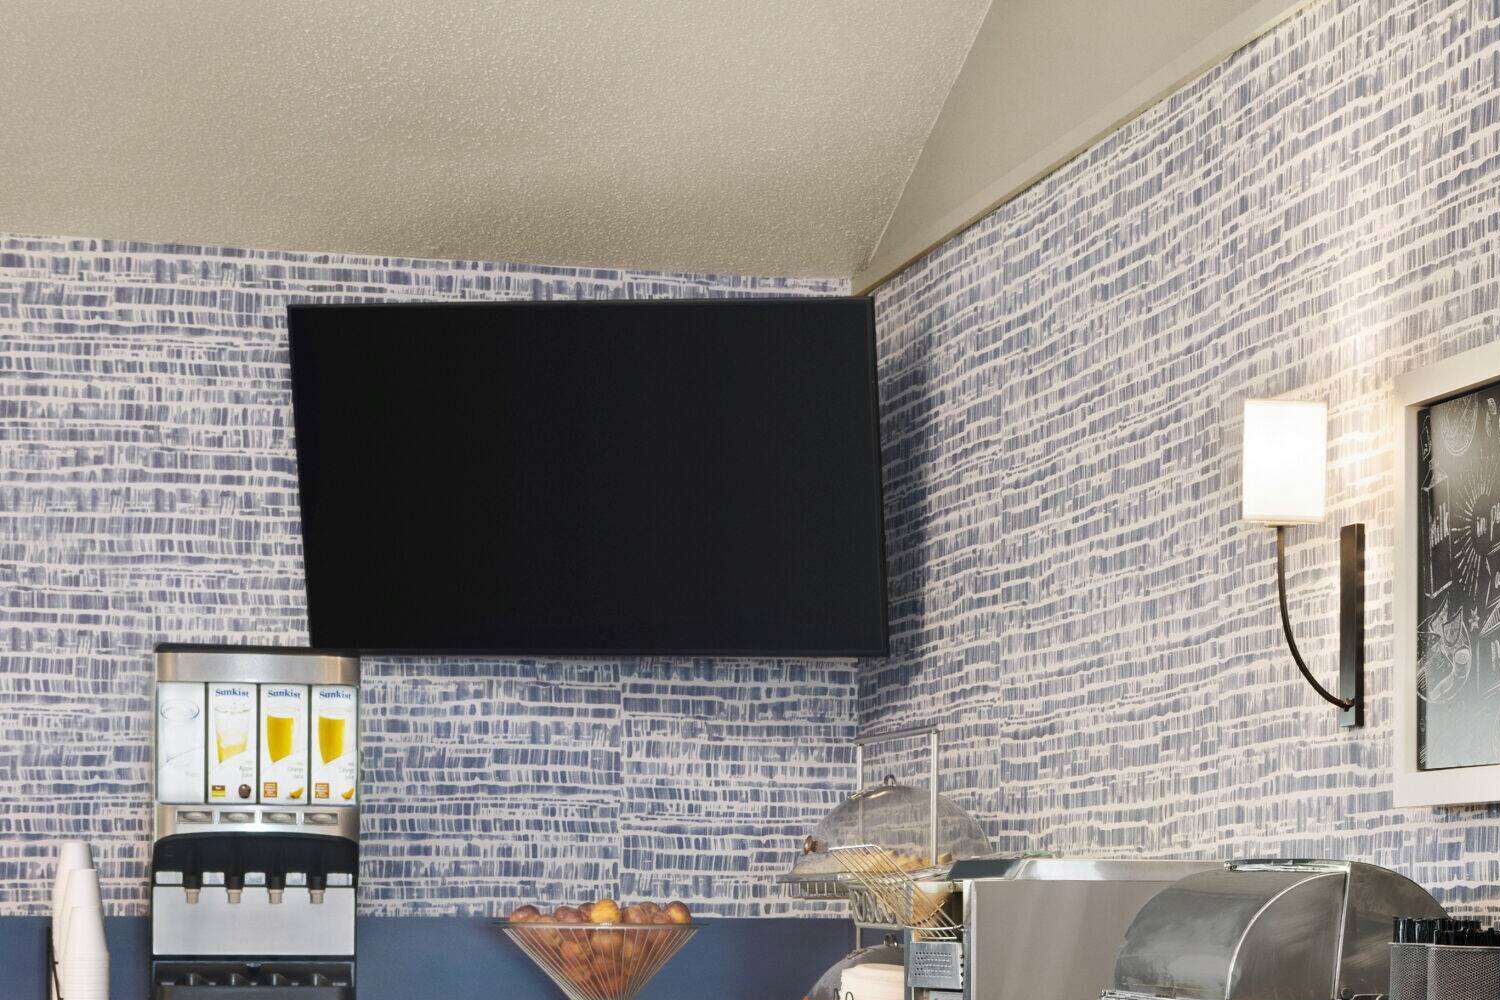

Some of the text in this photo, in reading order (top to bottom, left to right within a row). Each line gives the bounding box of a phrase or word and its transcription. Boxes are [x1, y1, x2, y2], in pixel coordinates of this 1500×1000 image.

[1476, 516, 1487, 538] in
[215, 688, 249, 698] Sunkist
[267, 688, 301, 699] Sunkist
[319, 689, 351, 700] Sunkist
